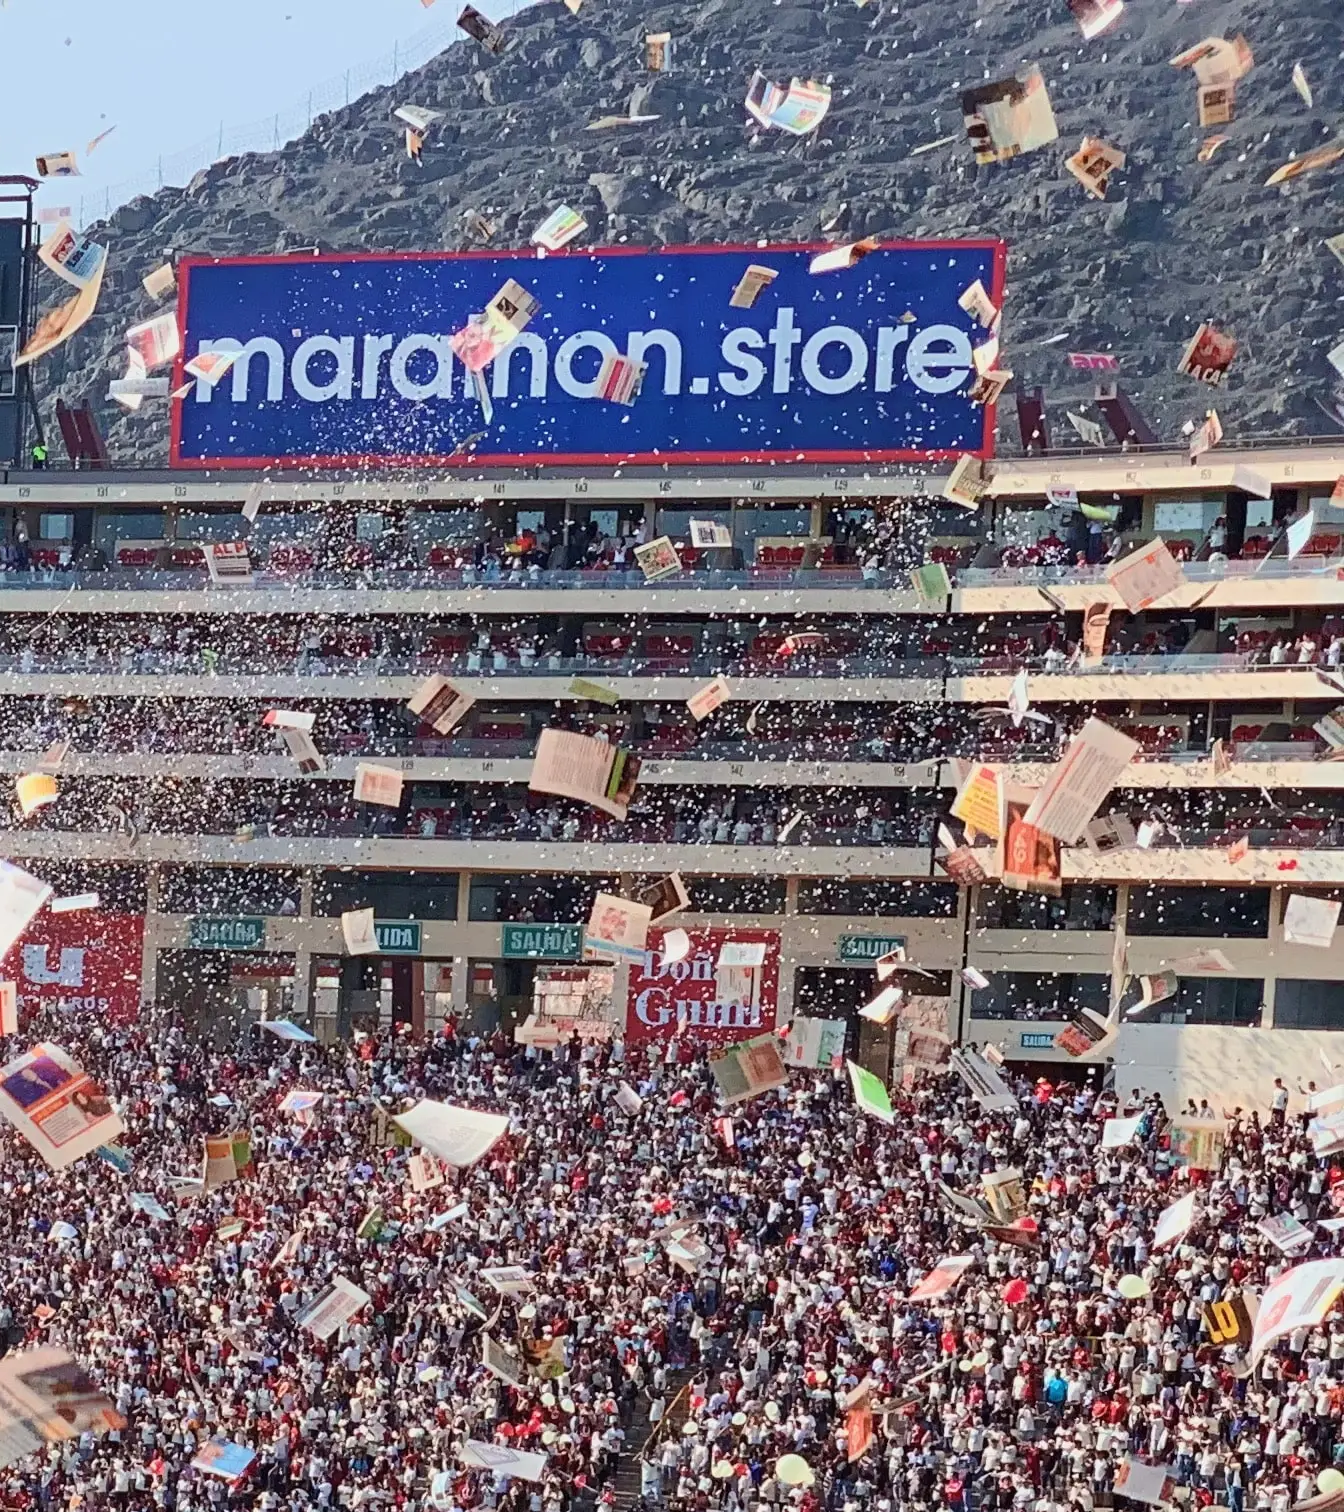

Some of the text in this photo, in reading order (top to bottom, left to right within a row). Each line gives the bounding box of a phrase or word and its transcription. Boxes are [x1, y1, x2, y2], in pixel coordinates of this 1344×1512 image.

[196, 307, 972, 403] marahon.store
[19, 488, 30, 498] 129
[97, 486, 108, 496] 131
[174, 486, 186, 496] 133
[333, 486, 345, 495] 137
[376, 924, 413, 946] LIDA
[511, 932, 573, 951] SALIDA
[643, 949, 712, 981] Doñ
[636, 987, 762, 1028] Gumi
[1023, 1035, 1054, 1047] SALIDA
